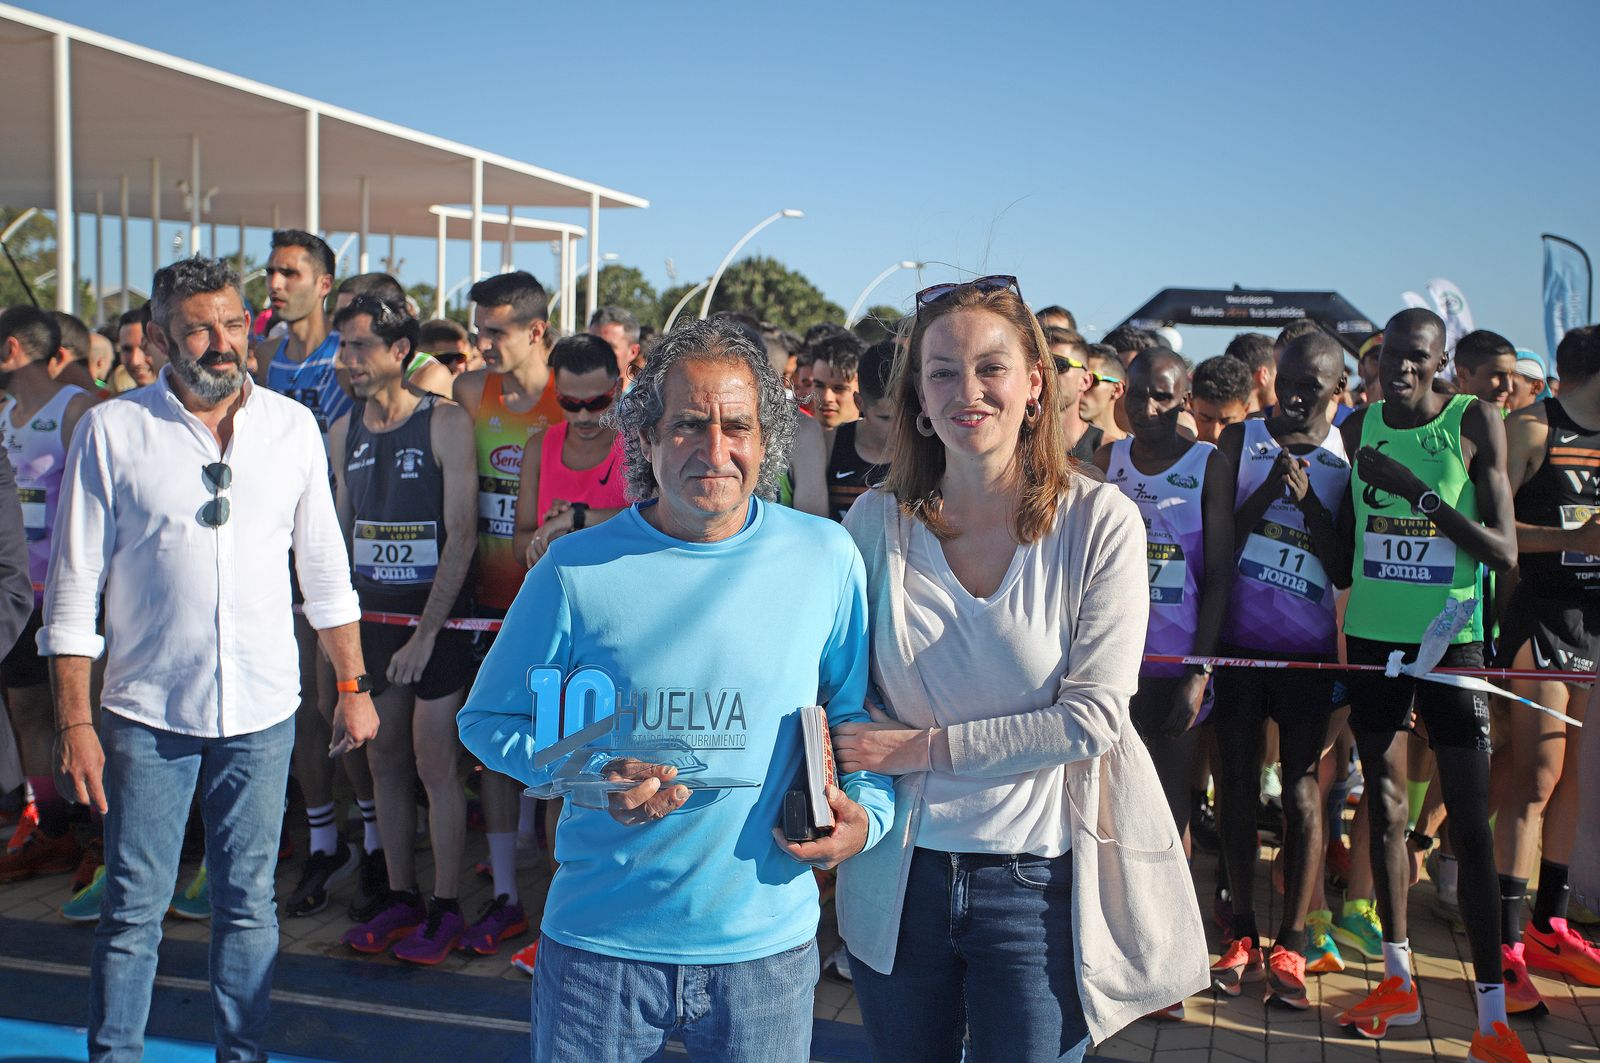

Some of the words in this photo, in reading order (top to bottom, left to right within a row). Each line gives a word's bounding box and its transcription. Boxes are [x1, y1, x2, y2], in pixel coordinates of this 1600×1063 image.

[380, 525, 424, 533] RUNNING
[1394, 518, 1437, 529] RUNNIN
[1405, 529, 1436, 537] LOOP
[372, 544, 415, 563] 202
[1147, 551, 1169, 560] OOP
[1382, 539, 1430, 562] 107
[1279, 548, 1305, 573] 11
[530, 668, 616, 753] 10
[615, 691, 747, 731] HUELVA
[668, 733, 747, 748] DESCUBRIMIENTO
